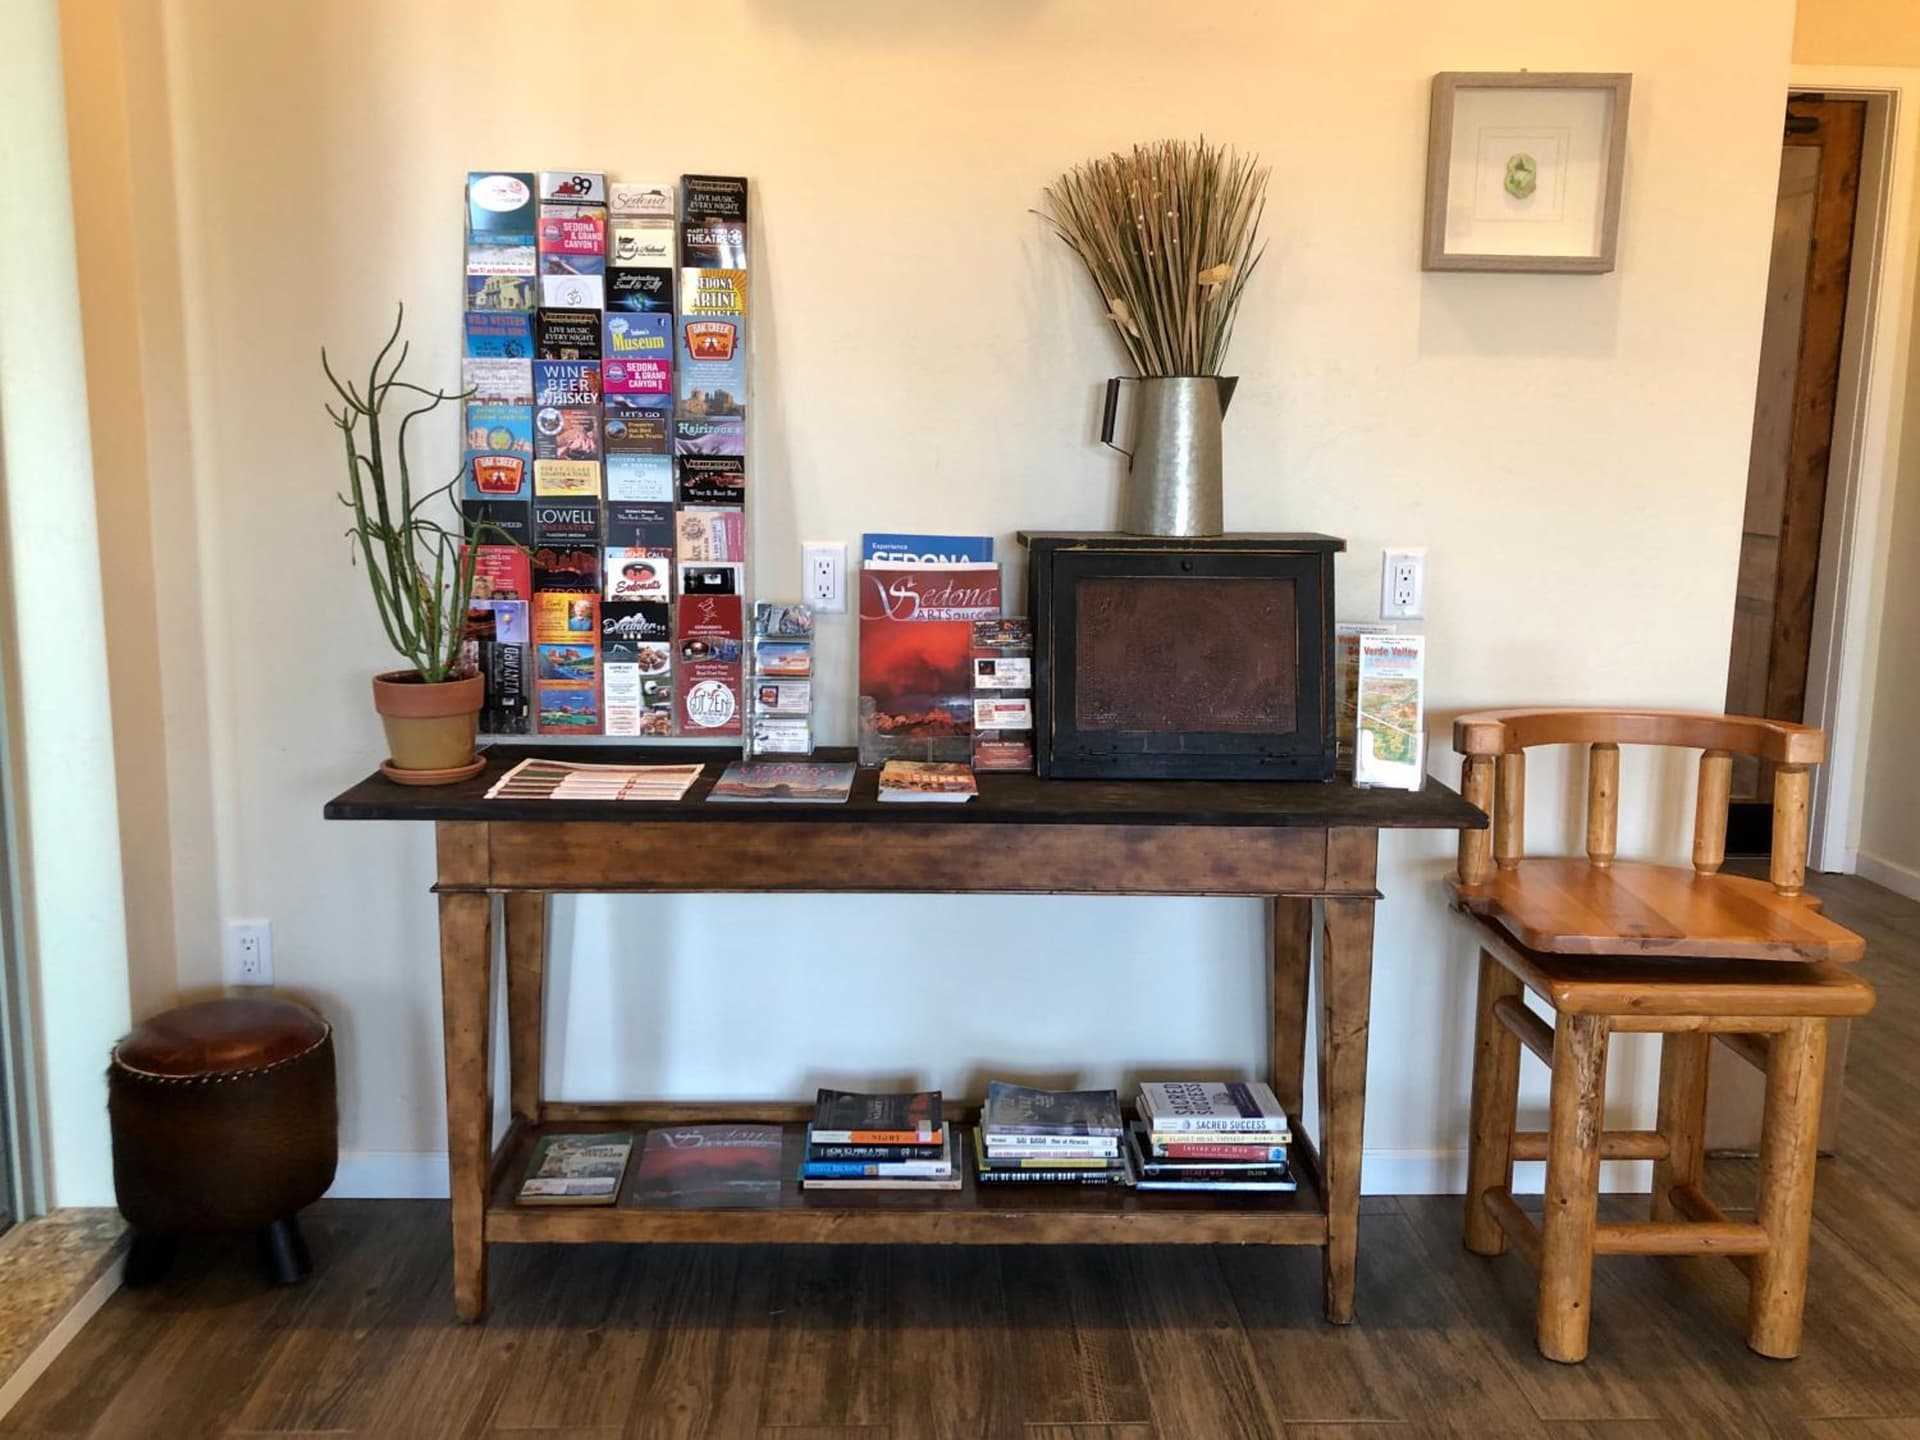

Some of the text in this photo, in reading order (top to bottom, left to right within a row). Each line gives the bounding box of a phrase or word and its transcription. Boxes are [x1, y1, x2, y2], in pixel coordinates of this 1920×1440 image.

[572, 176, 593, 195] 89
[612, 192, 665, 209] Sedona
[711, 195, 736, 203] MUSIC
[713, 202, 739, 211] NIGHT
[563, 222, 594, 232] SEDONA
[578, 232, 602, 241] GRAND
[564, 240, 593, 249] CANYON
[613, 281, 632, 289] Soul
[643, 281, 662, 292] Self
[693, 293, 736, 308] ARTIST
[568, 334, 595, 342] NIGHT
[612, 332, 665, 352] Museum
[543, 365, 589, 378] WINE
[626, 362, 658, 372] SEDONA
[641, 372, 666, 380] GRAND
[548, 379, 590, 392] BEER
[629, 380, 657, 388] CANYON
[540, 392, 599, 405] WHISKEY
[536, 509, 595, 524] LOWELL
[872, 542, 908, 551] Experience
[872, 551, 970, 563] SEDONA
[915, 608, 990, 621] ARTSource
[1364, 646, 1418, 659] Verde Valley
[1163, 1083, 1194, 1116] SACRED
[1183, 1083, 1215, 1116] SUCCESS
[1196, 1120, 1267, 1129] SACRED SUCCESS
